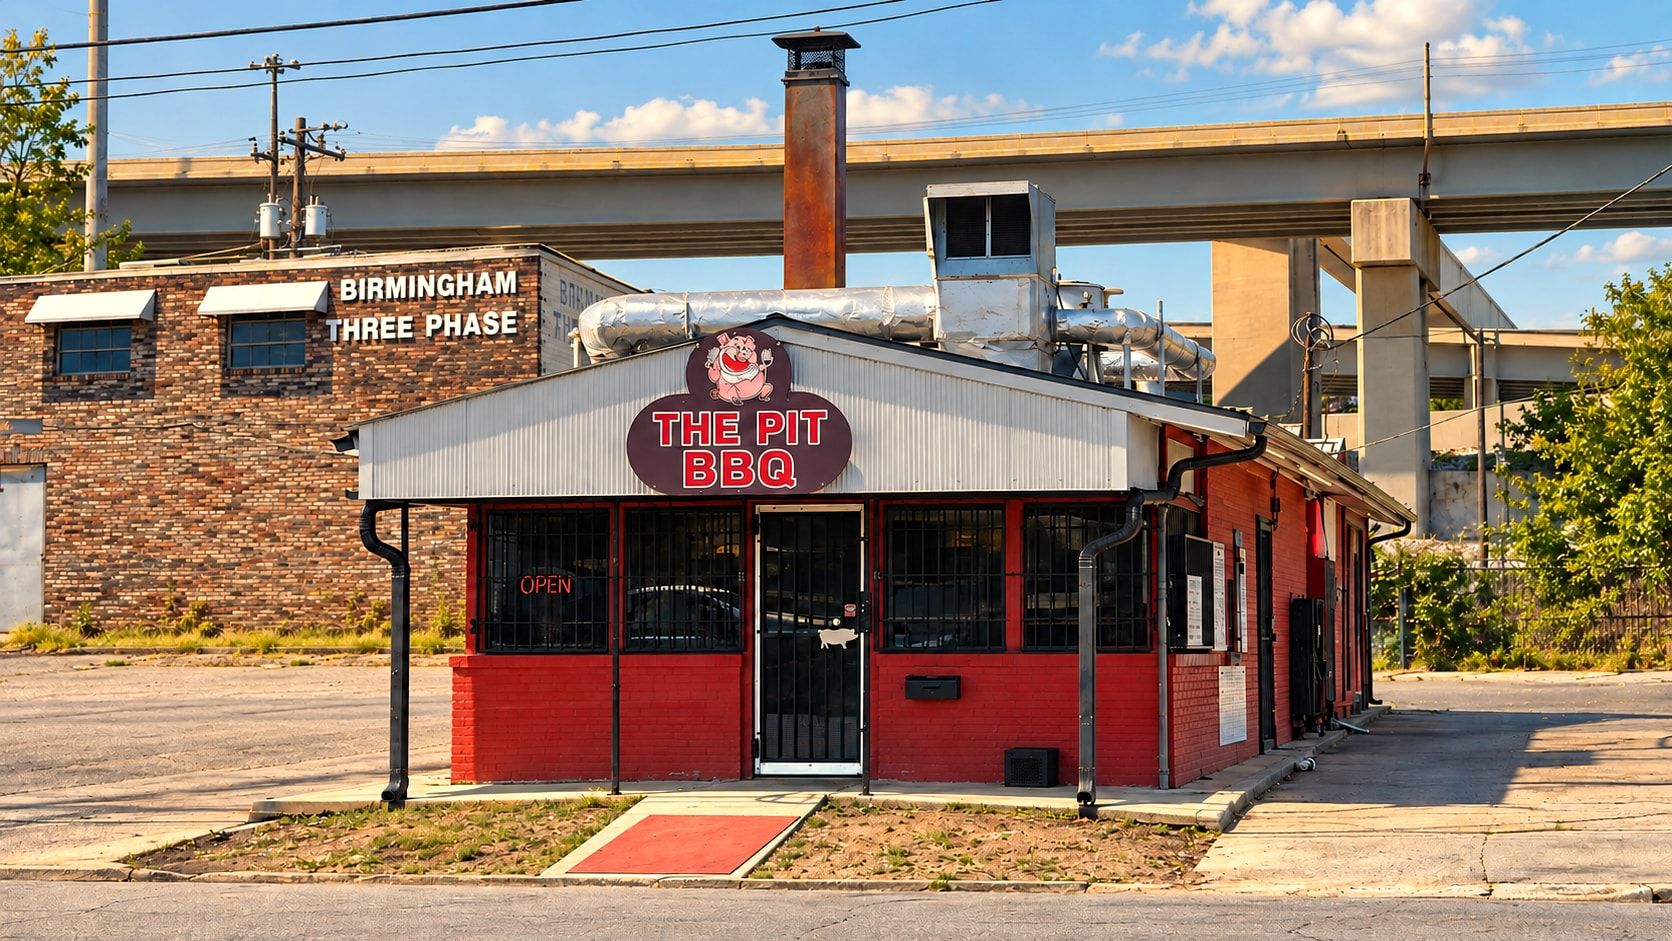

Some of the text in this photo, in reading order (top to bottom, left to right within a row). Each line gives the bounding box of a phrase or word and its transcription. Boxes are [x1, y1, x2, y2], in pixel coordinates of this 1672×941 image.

[340, 271, 517, 301] BIRMINGHAM
[326, 311, 517, 342] THREE PHASE
[652, 409, 828, 447] THE PIT
[682, 448, 797, 490] BBQ
[520, 575, 572, 596] OPEN
